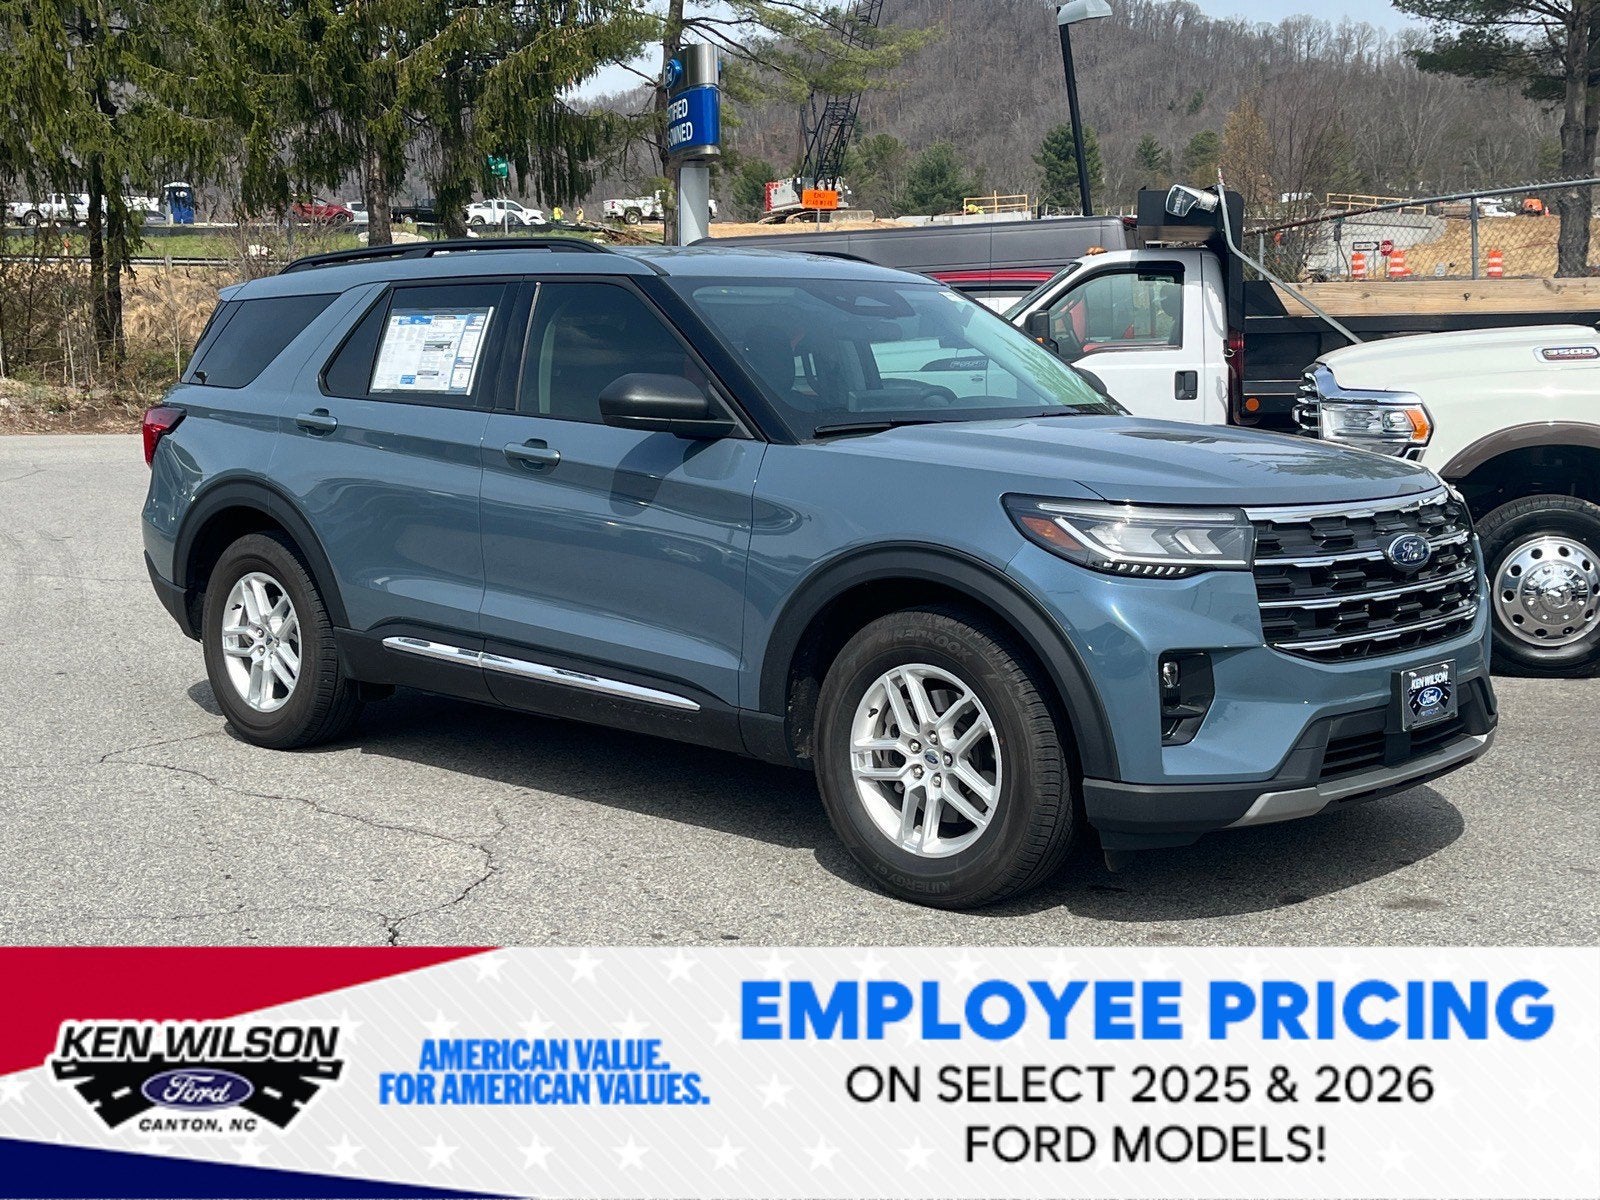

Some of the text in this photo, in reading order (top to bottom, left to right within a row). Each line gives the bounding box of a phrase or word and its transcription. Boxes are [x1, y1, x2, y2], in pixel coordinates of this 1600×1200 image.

[1401, 541, 1425, 562] Ford
[1411, 671, 1448, 690] KEN WILSON
[1422, 689, 1439, 705] Ford
